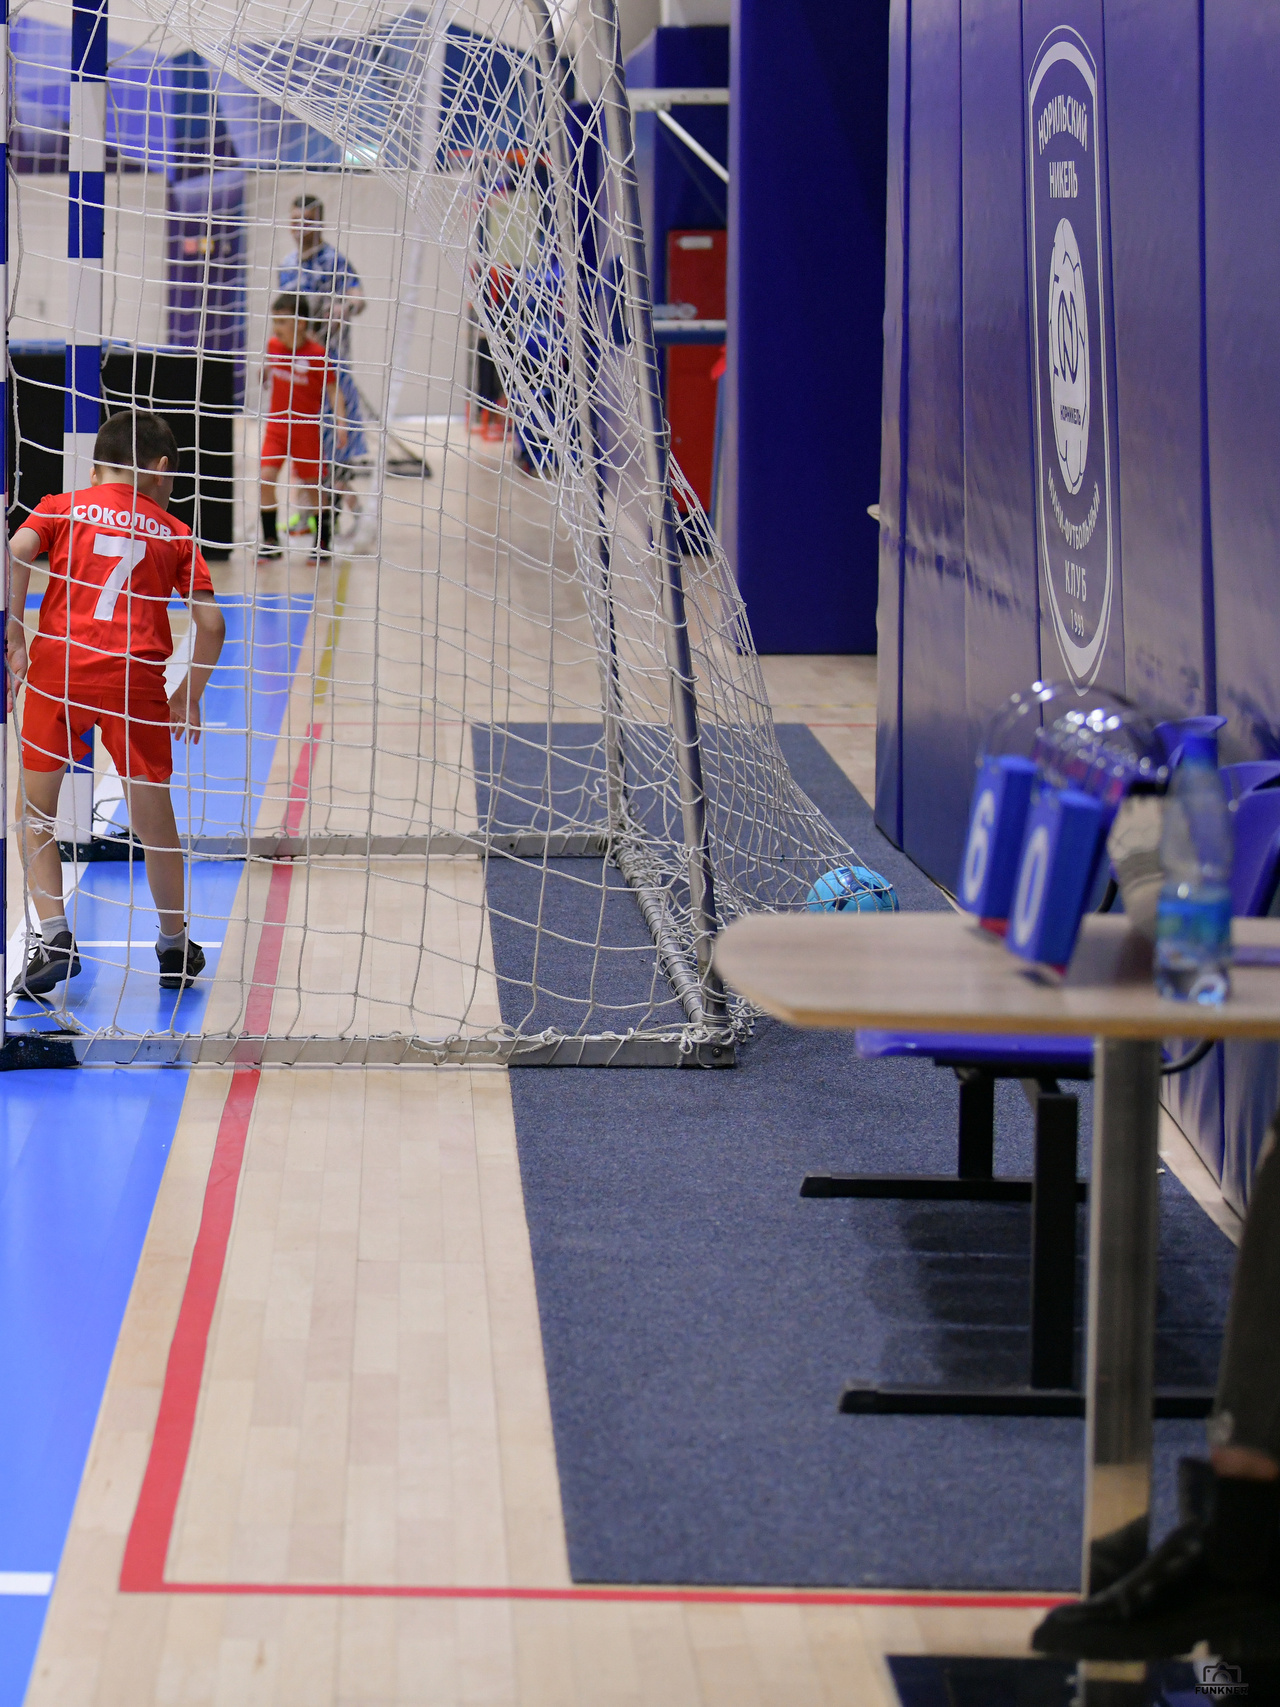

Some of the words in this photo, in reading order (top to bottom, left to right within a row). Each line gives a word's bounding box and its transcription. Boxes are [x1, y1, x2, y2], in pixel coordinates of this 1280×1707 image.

[1038, 95, 1087, 155] НОРИЛЬСКИЙ
[1049, 161, 1078, 198] НИКЕЛЬ
[73, 504, 172, 542] СОКОЛОВ
[93, 533, 146, 621] 7
[1064, 560, 1087, 602] КЛУБ
